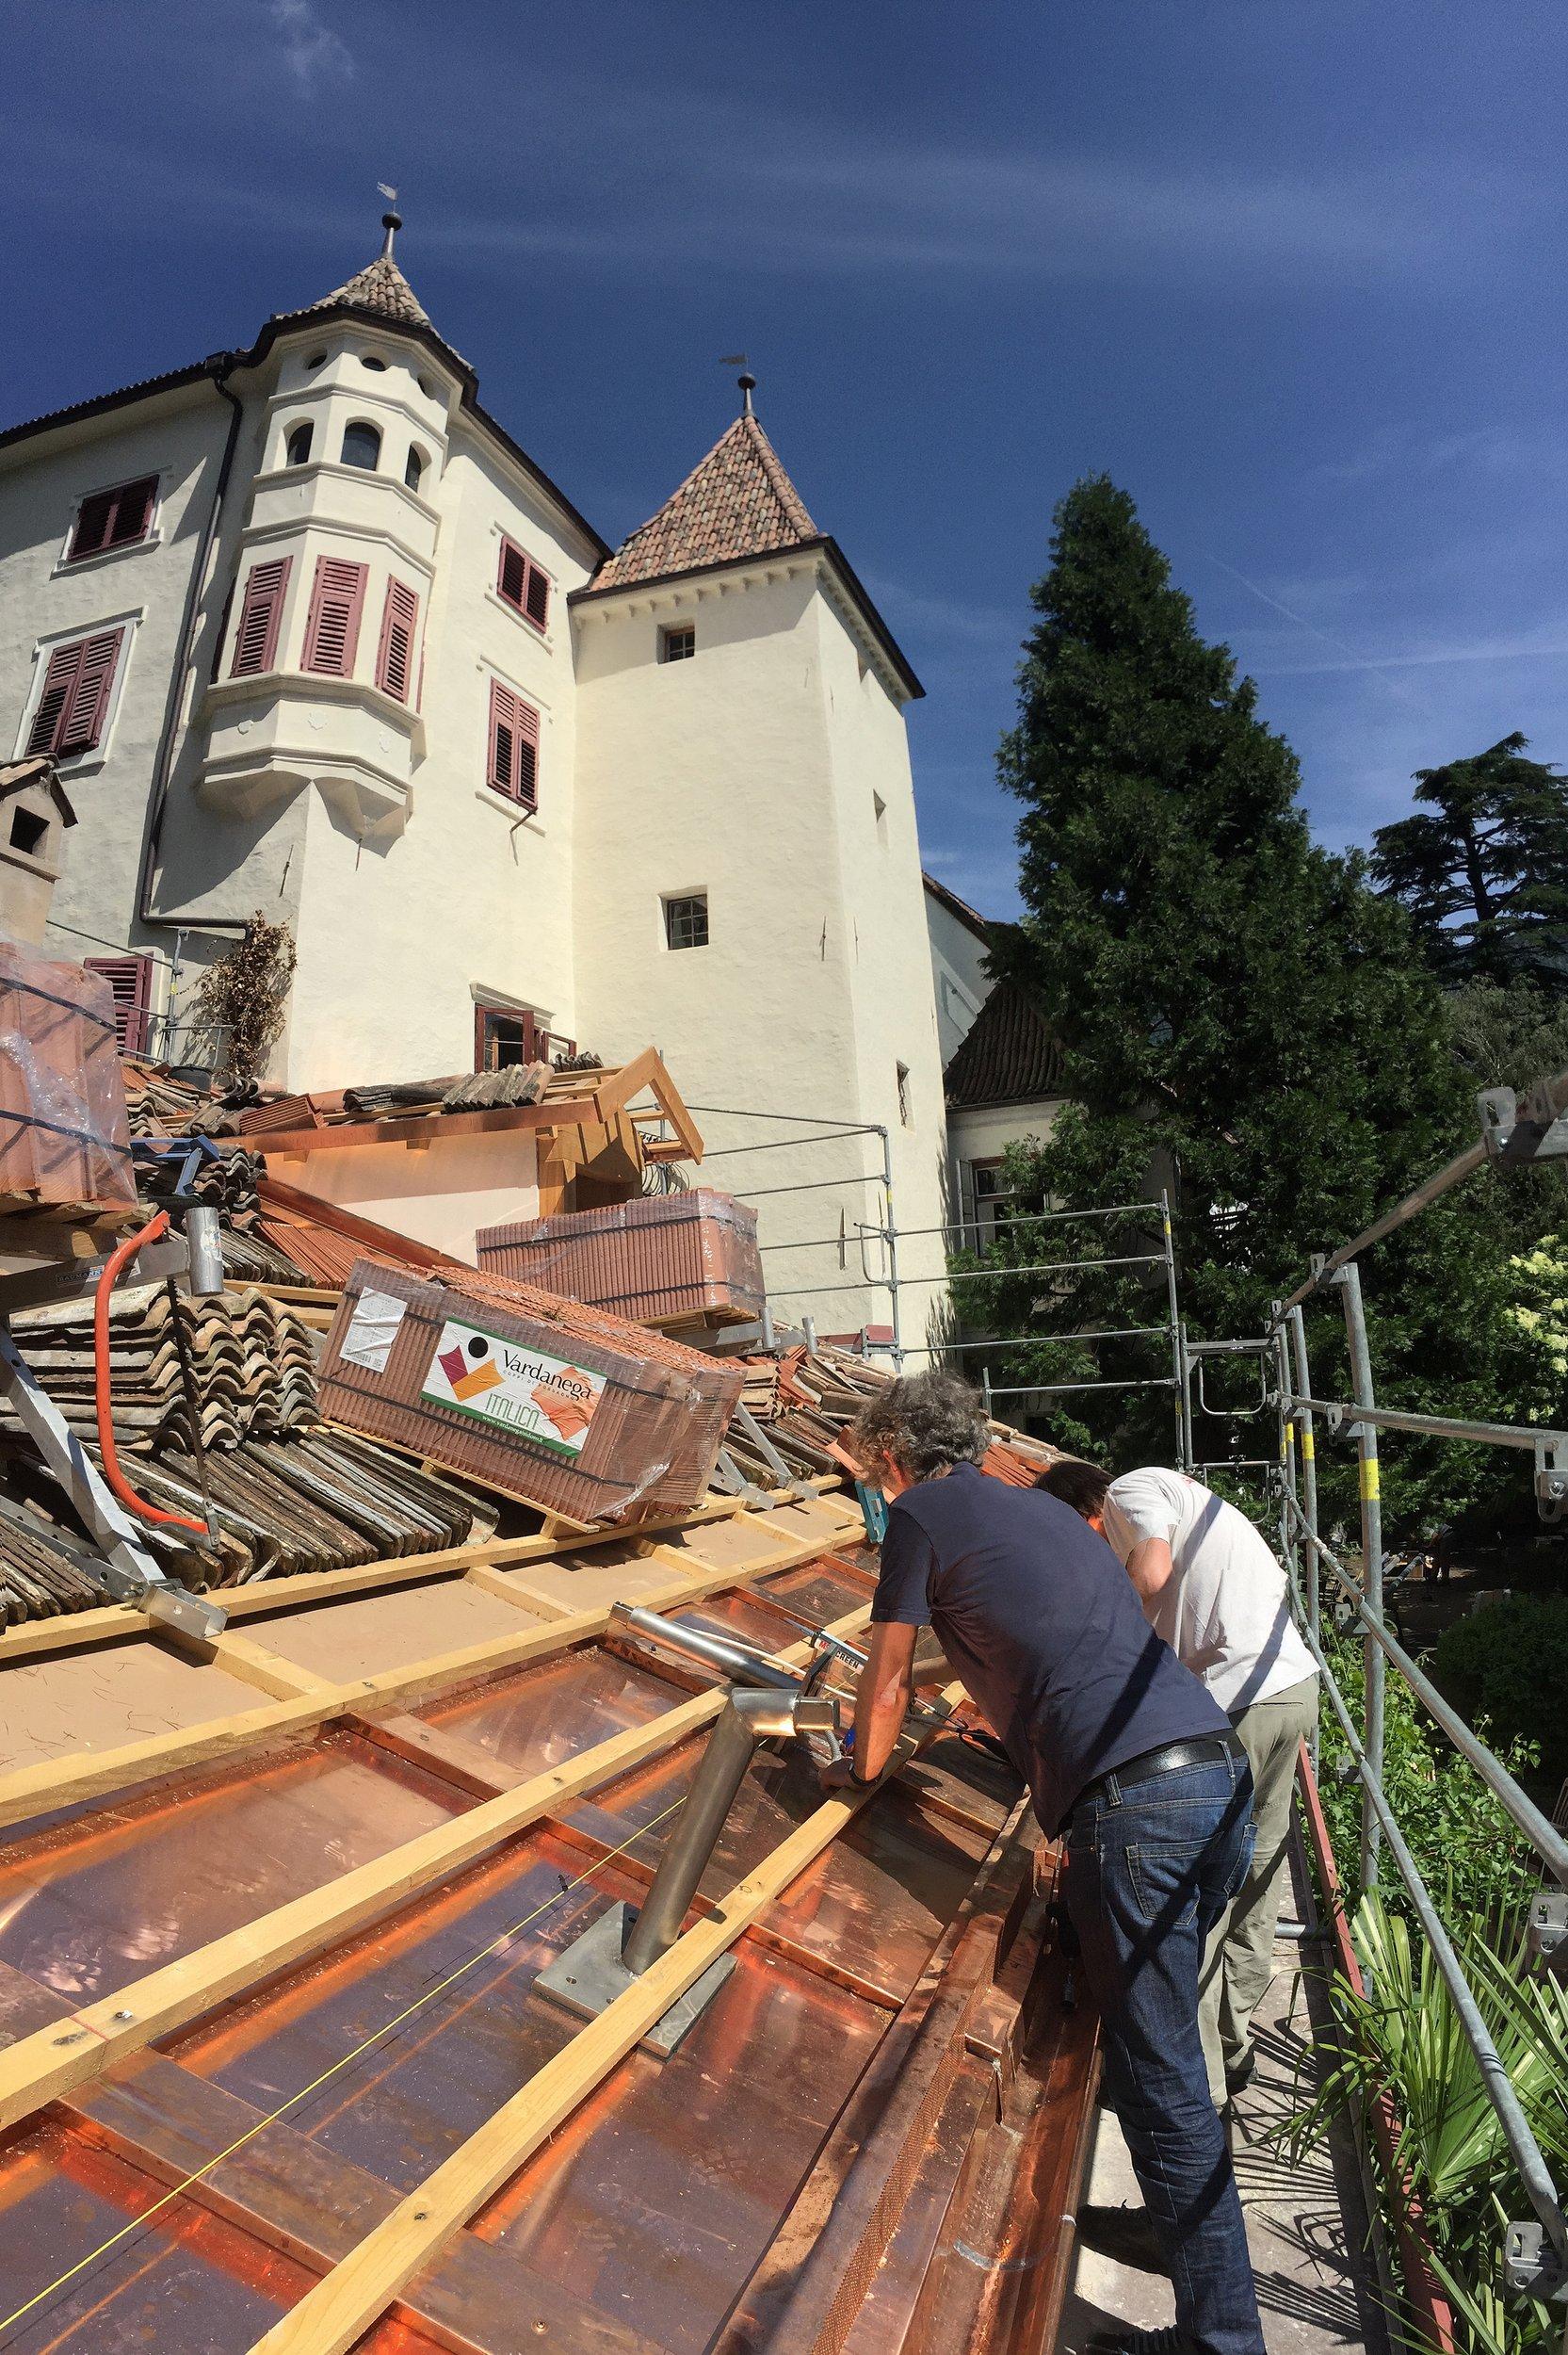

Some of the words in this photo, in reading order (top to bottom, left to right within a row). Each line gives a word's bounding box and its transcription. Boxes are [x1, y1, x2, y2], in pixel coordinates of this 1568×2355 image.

[504, 1349, 592, 1402] Vardanega
[485, 1393, 540, 1430] ITALICA
[835, 1650, 859, 1669] CREEN
